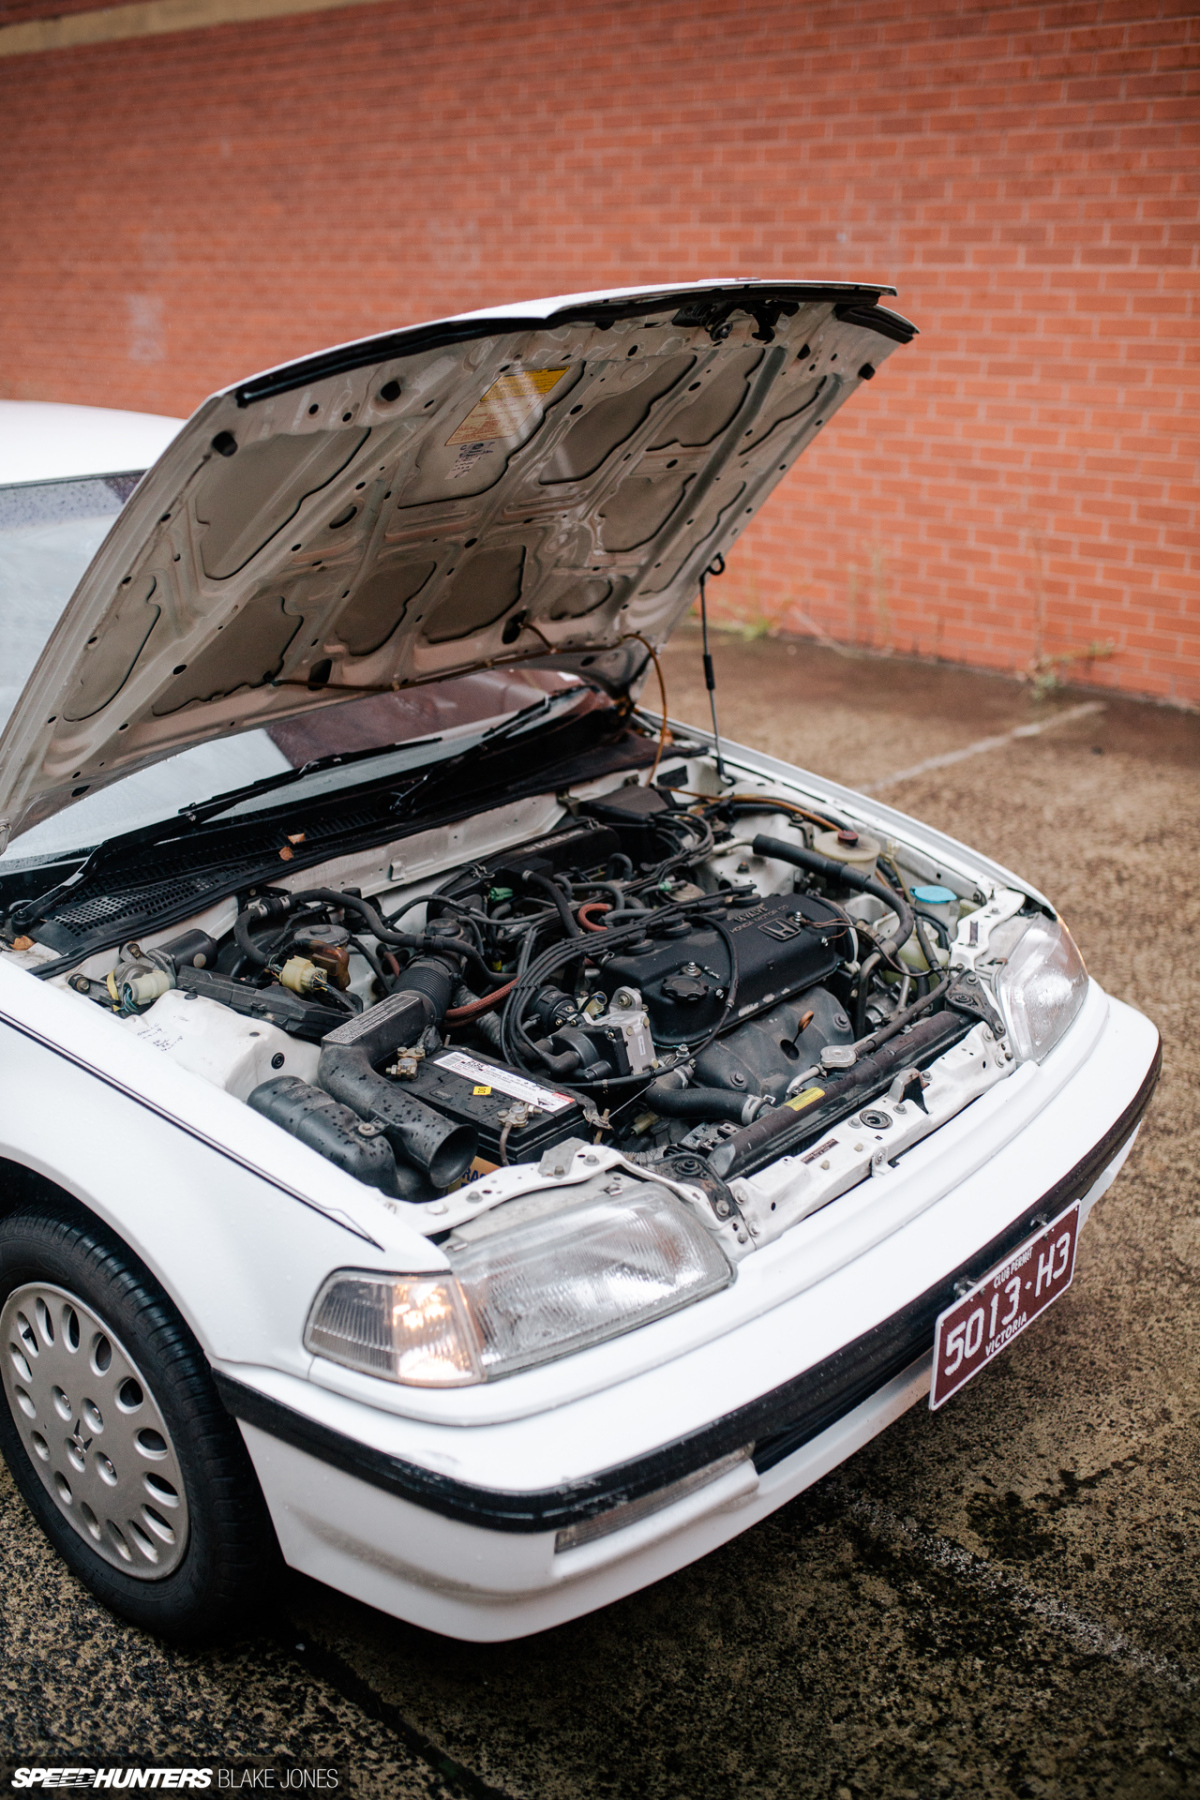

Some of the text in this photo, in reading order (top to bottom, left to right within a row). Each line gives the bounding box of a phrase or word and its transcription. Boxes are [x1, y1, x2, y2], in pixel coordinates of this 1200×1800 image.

[462, 1167, 486, 1182] RA
[993, 1246, 1033, 1289] CLUB PERMIT
[985, 1311, 1027, 1356] VICTORIA
